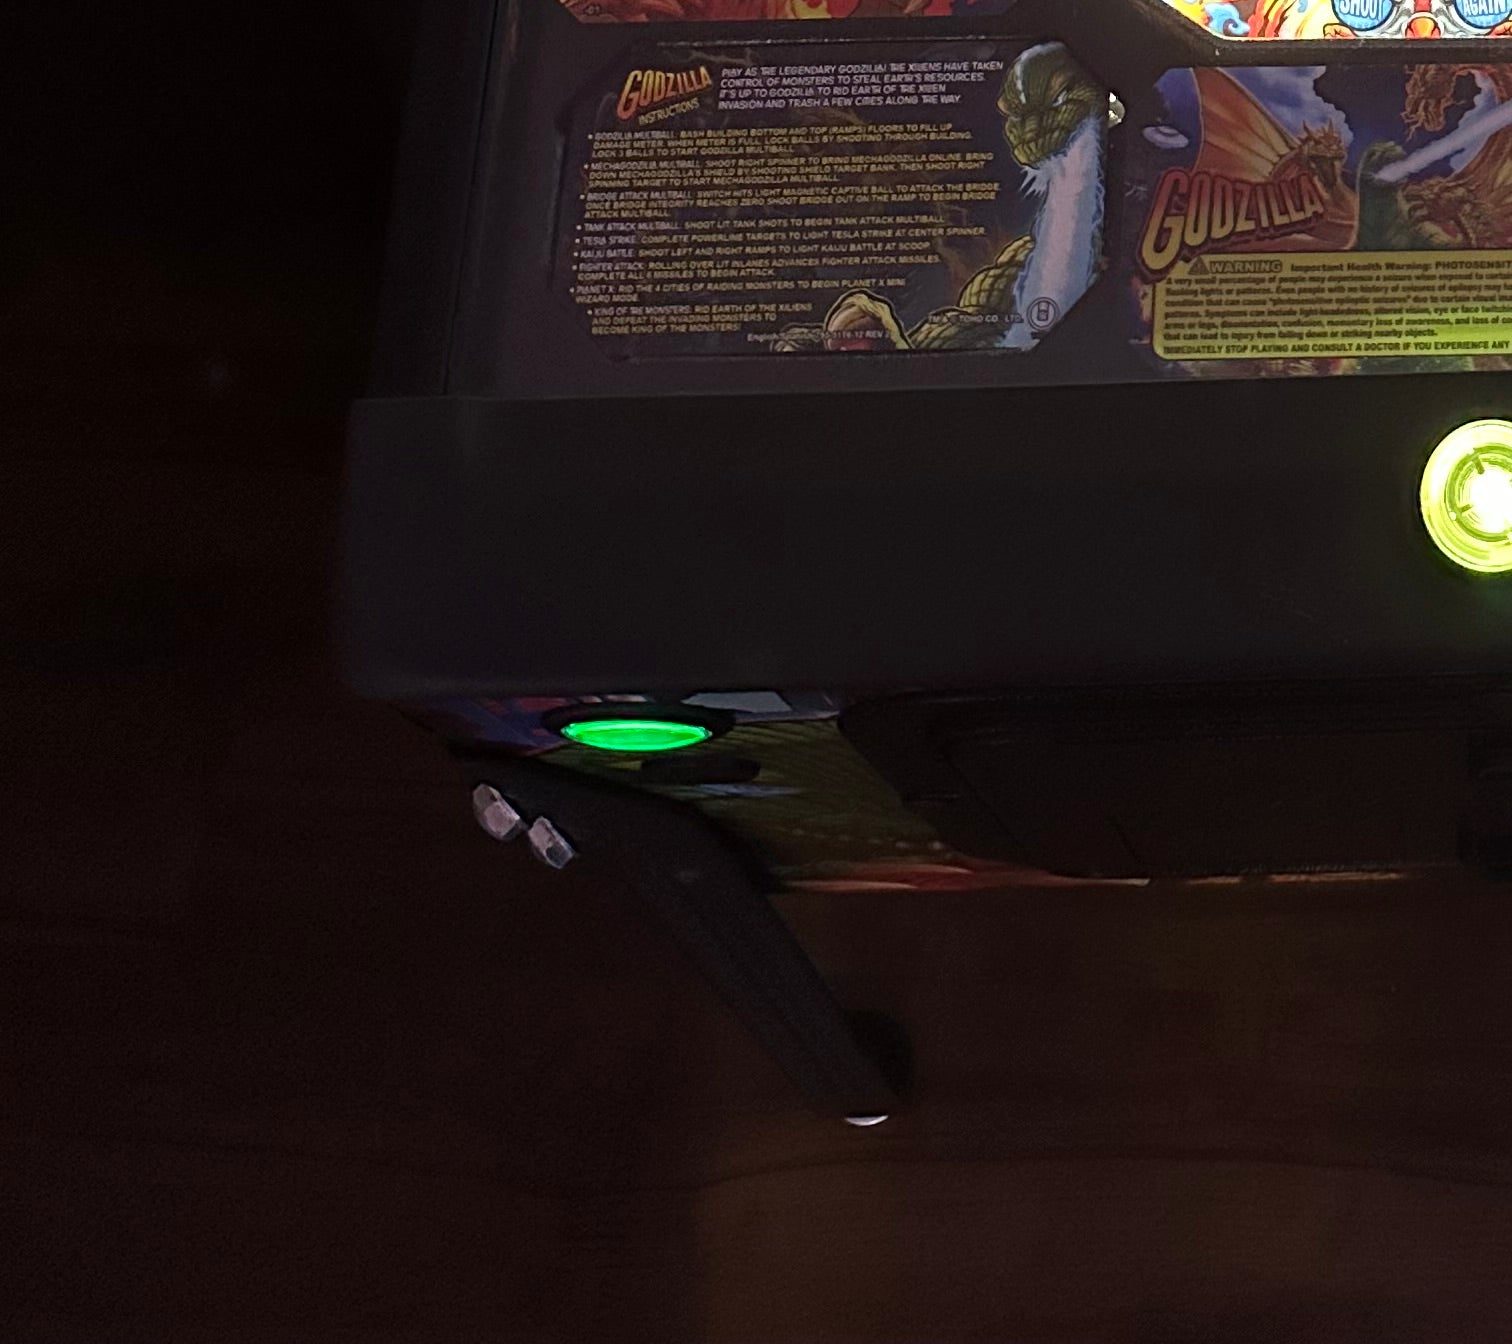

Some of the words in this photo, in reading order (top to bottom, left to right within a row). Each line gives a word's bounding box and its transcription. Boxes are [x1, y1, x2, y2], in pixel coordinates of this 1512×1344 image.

[779, 66, 835, 75] LEGENDARY
[972, 61, 1003, 71] TAKEN
[767, 78, 779, 87] OF
[782, 76, 834, 86] MONSTERS
[838, 76, 850, 85] TO
[853, 75, 881, 84] STEAL
[616, 66, 712, 121] GODZILLA
[739, 89, 751, 98] UP
[754, 88, 766, 98] TO
[718, 99, 763, 109] INVASION
[765, 99, 785, 108] AND
[788, 98, 820, 108] TRASH
[831, 97, 849, 107] FEW
[639, 97, 700, 126] INSTRUCTIONS
[1141, 170, 1325, 274] GODZILLA
[1209, 261, 1282, 274] WARNING
[1312, 343, 1352, 353] CONSULT
[1364, 342, 1400, 352] DOCTOR
[1413, 341, 1432, 351] YOU
[1434, 340, 1489, 351] EXPERIENCE
